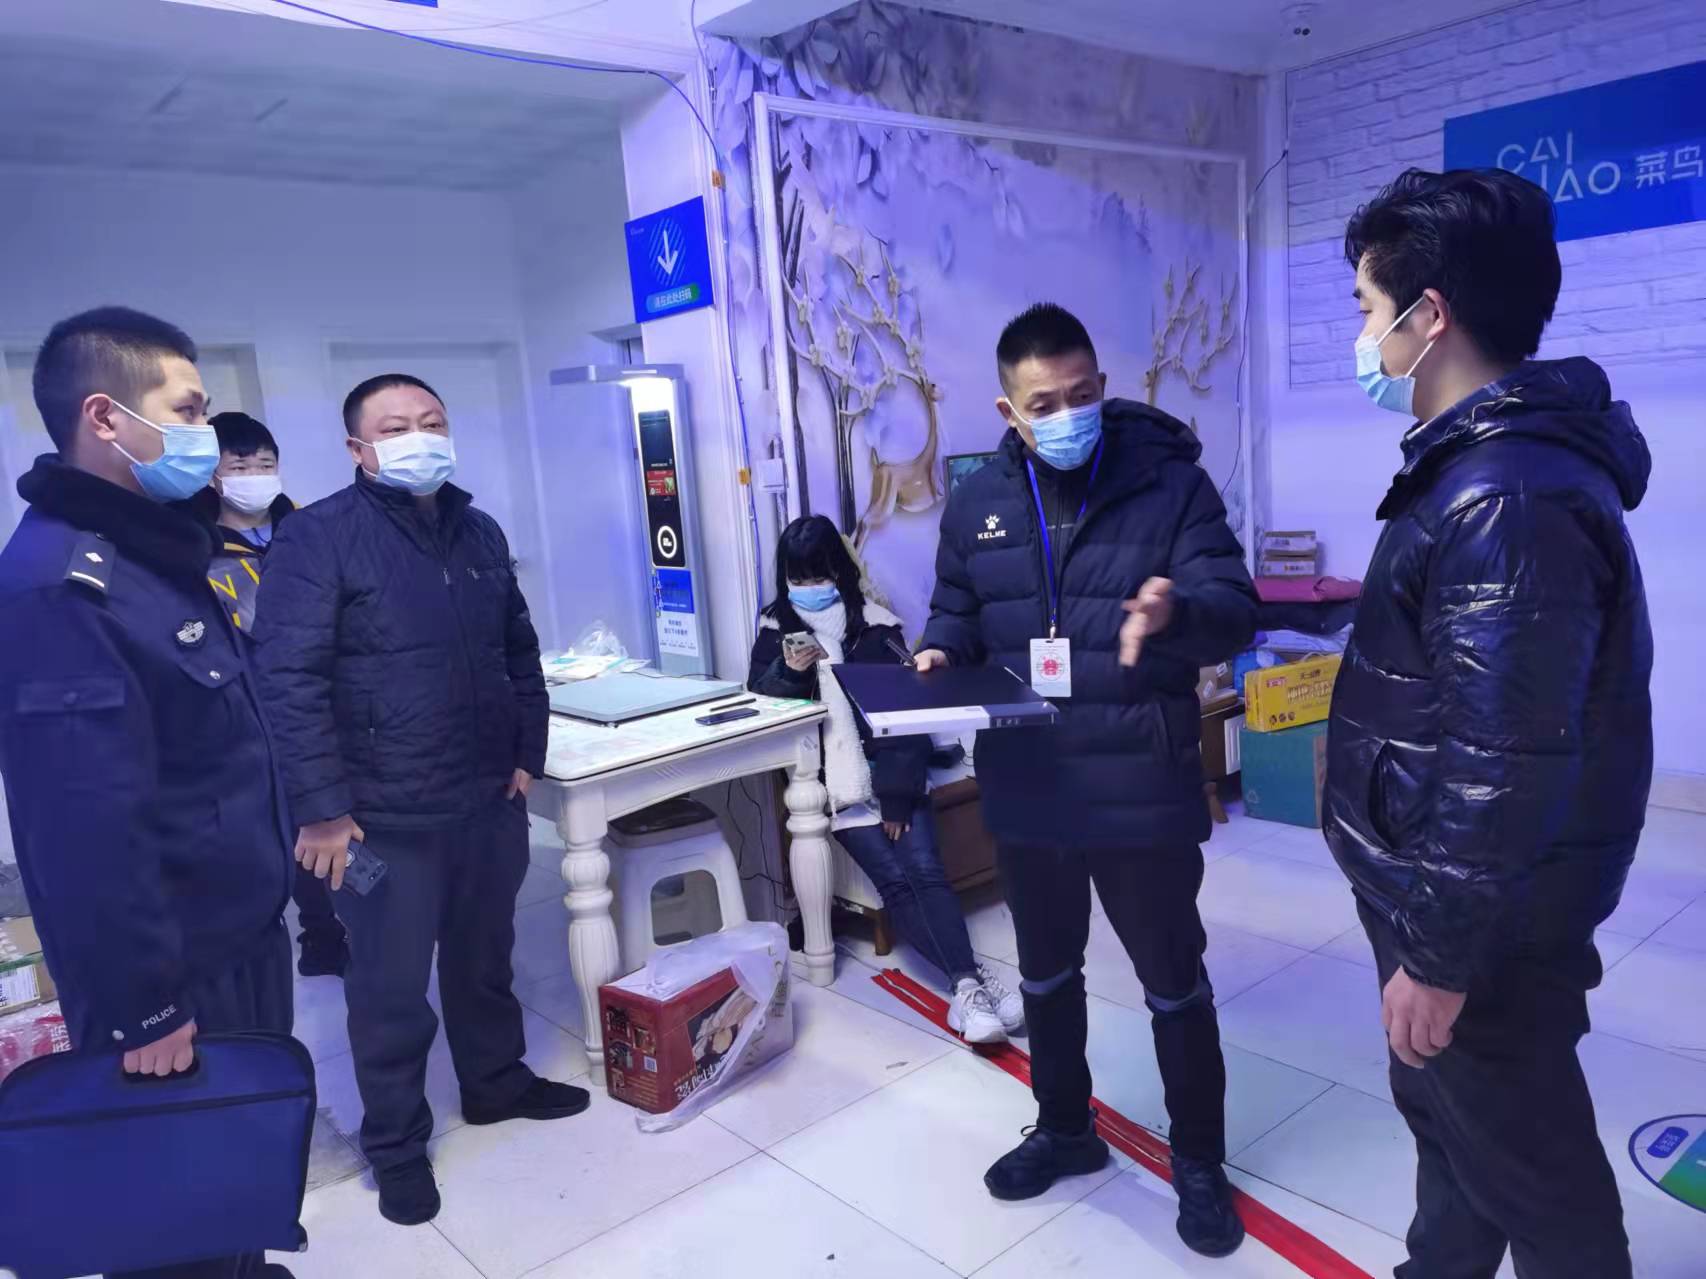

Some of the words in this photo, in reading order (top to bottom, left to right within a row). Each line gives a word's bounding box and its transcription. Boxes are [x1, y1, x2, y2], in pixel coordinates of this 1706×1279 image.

[1496, 129, 1573, 173] CAI
[1635, 146, 1704, 189] 菜鸟
[1540, 161, 1621, 202] IAO
[976, 529, 1007, 541] KELME
[141, 1003, 177, 1030] POLICE
